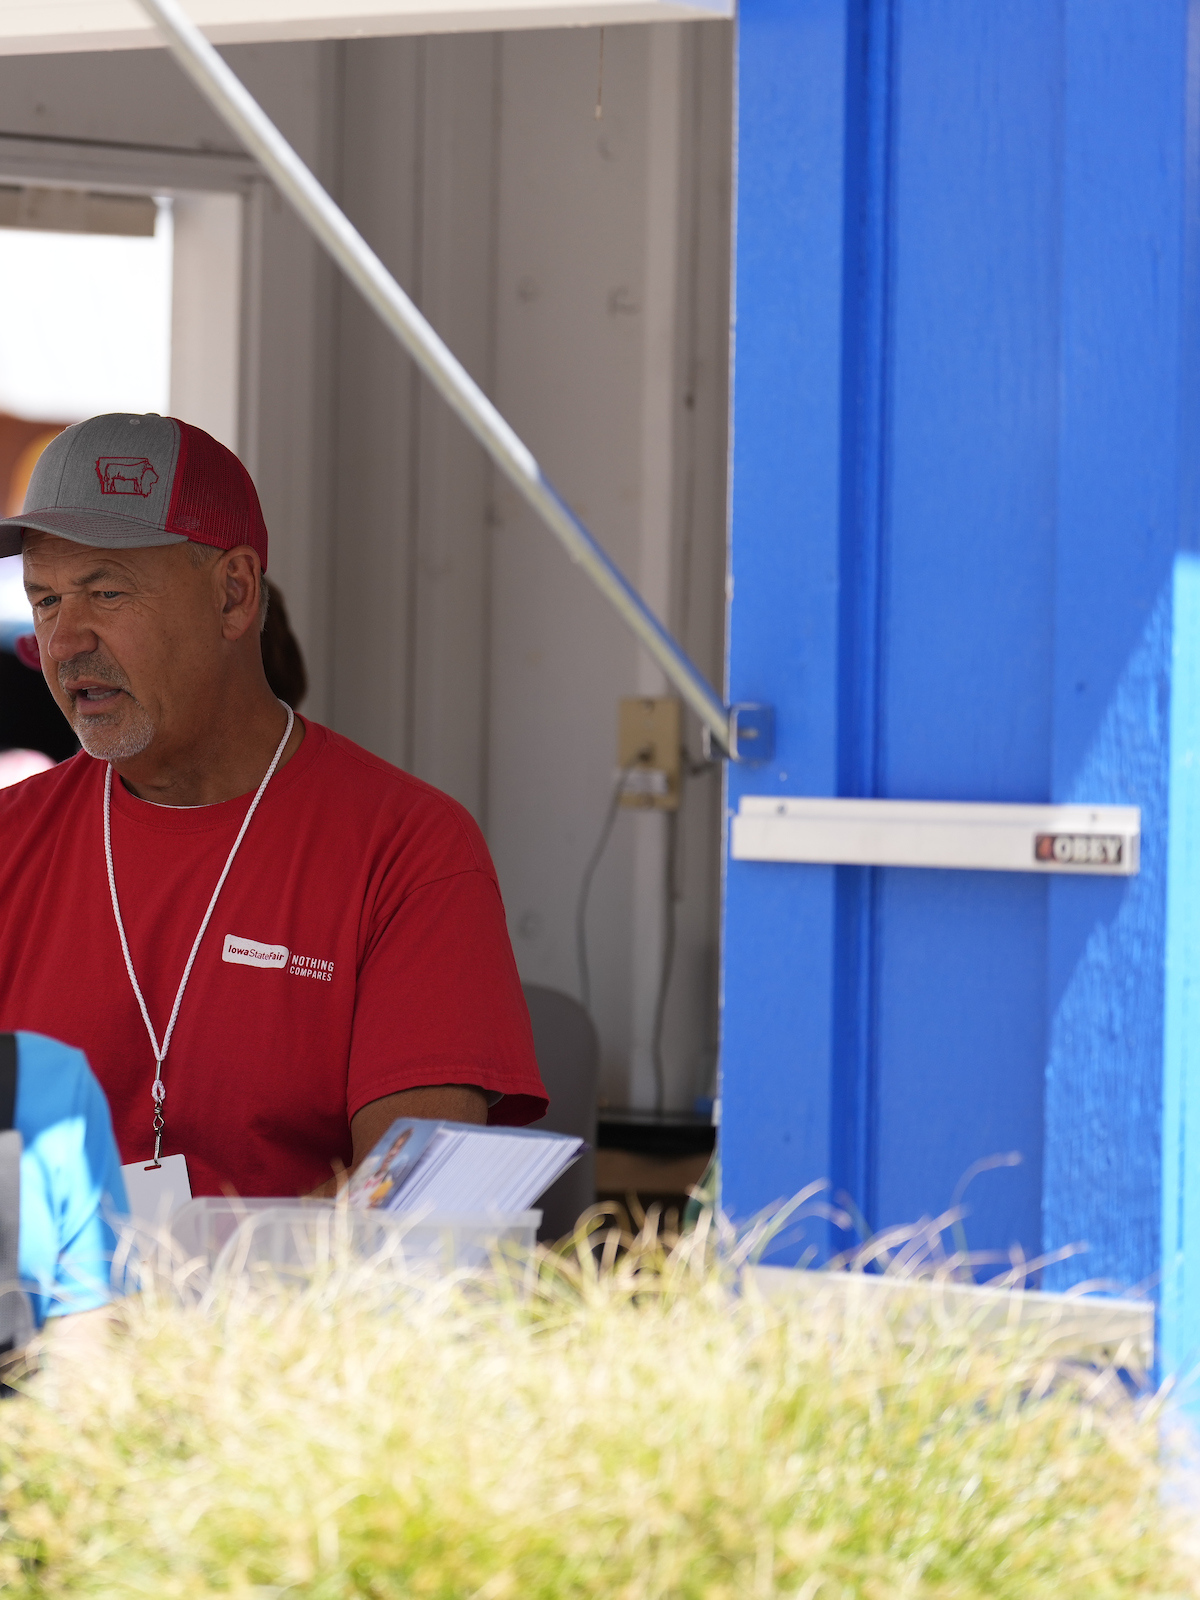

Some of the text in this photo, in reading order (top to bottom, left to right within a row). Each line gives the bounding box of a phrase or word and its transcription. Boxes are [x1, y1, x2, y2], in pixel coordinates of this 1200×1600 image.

[1053, 836, 1123, 862] OBEY
[228, 945, 285, 961] IowaStateFair
[291, 955, 335, 972] NOTHING
[289, 966, 333, 982] COMPARES
